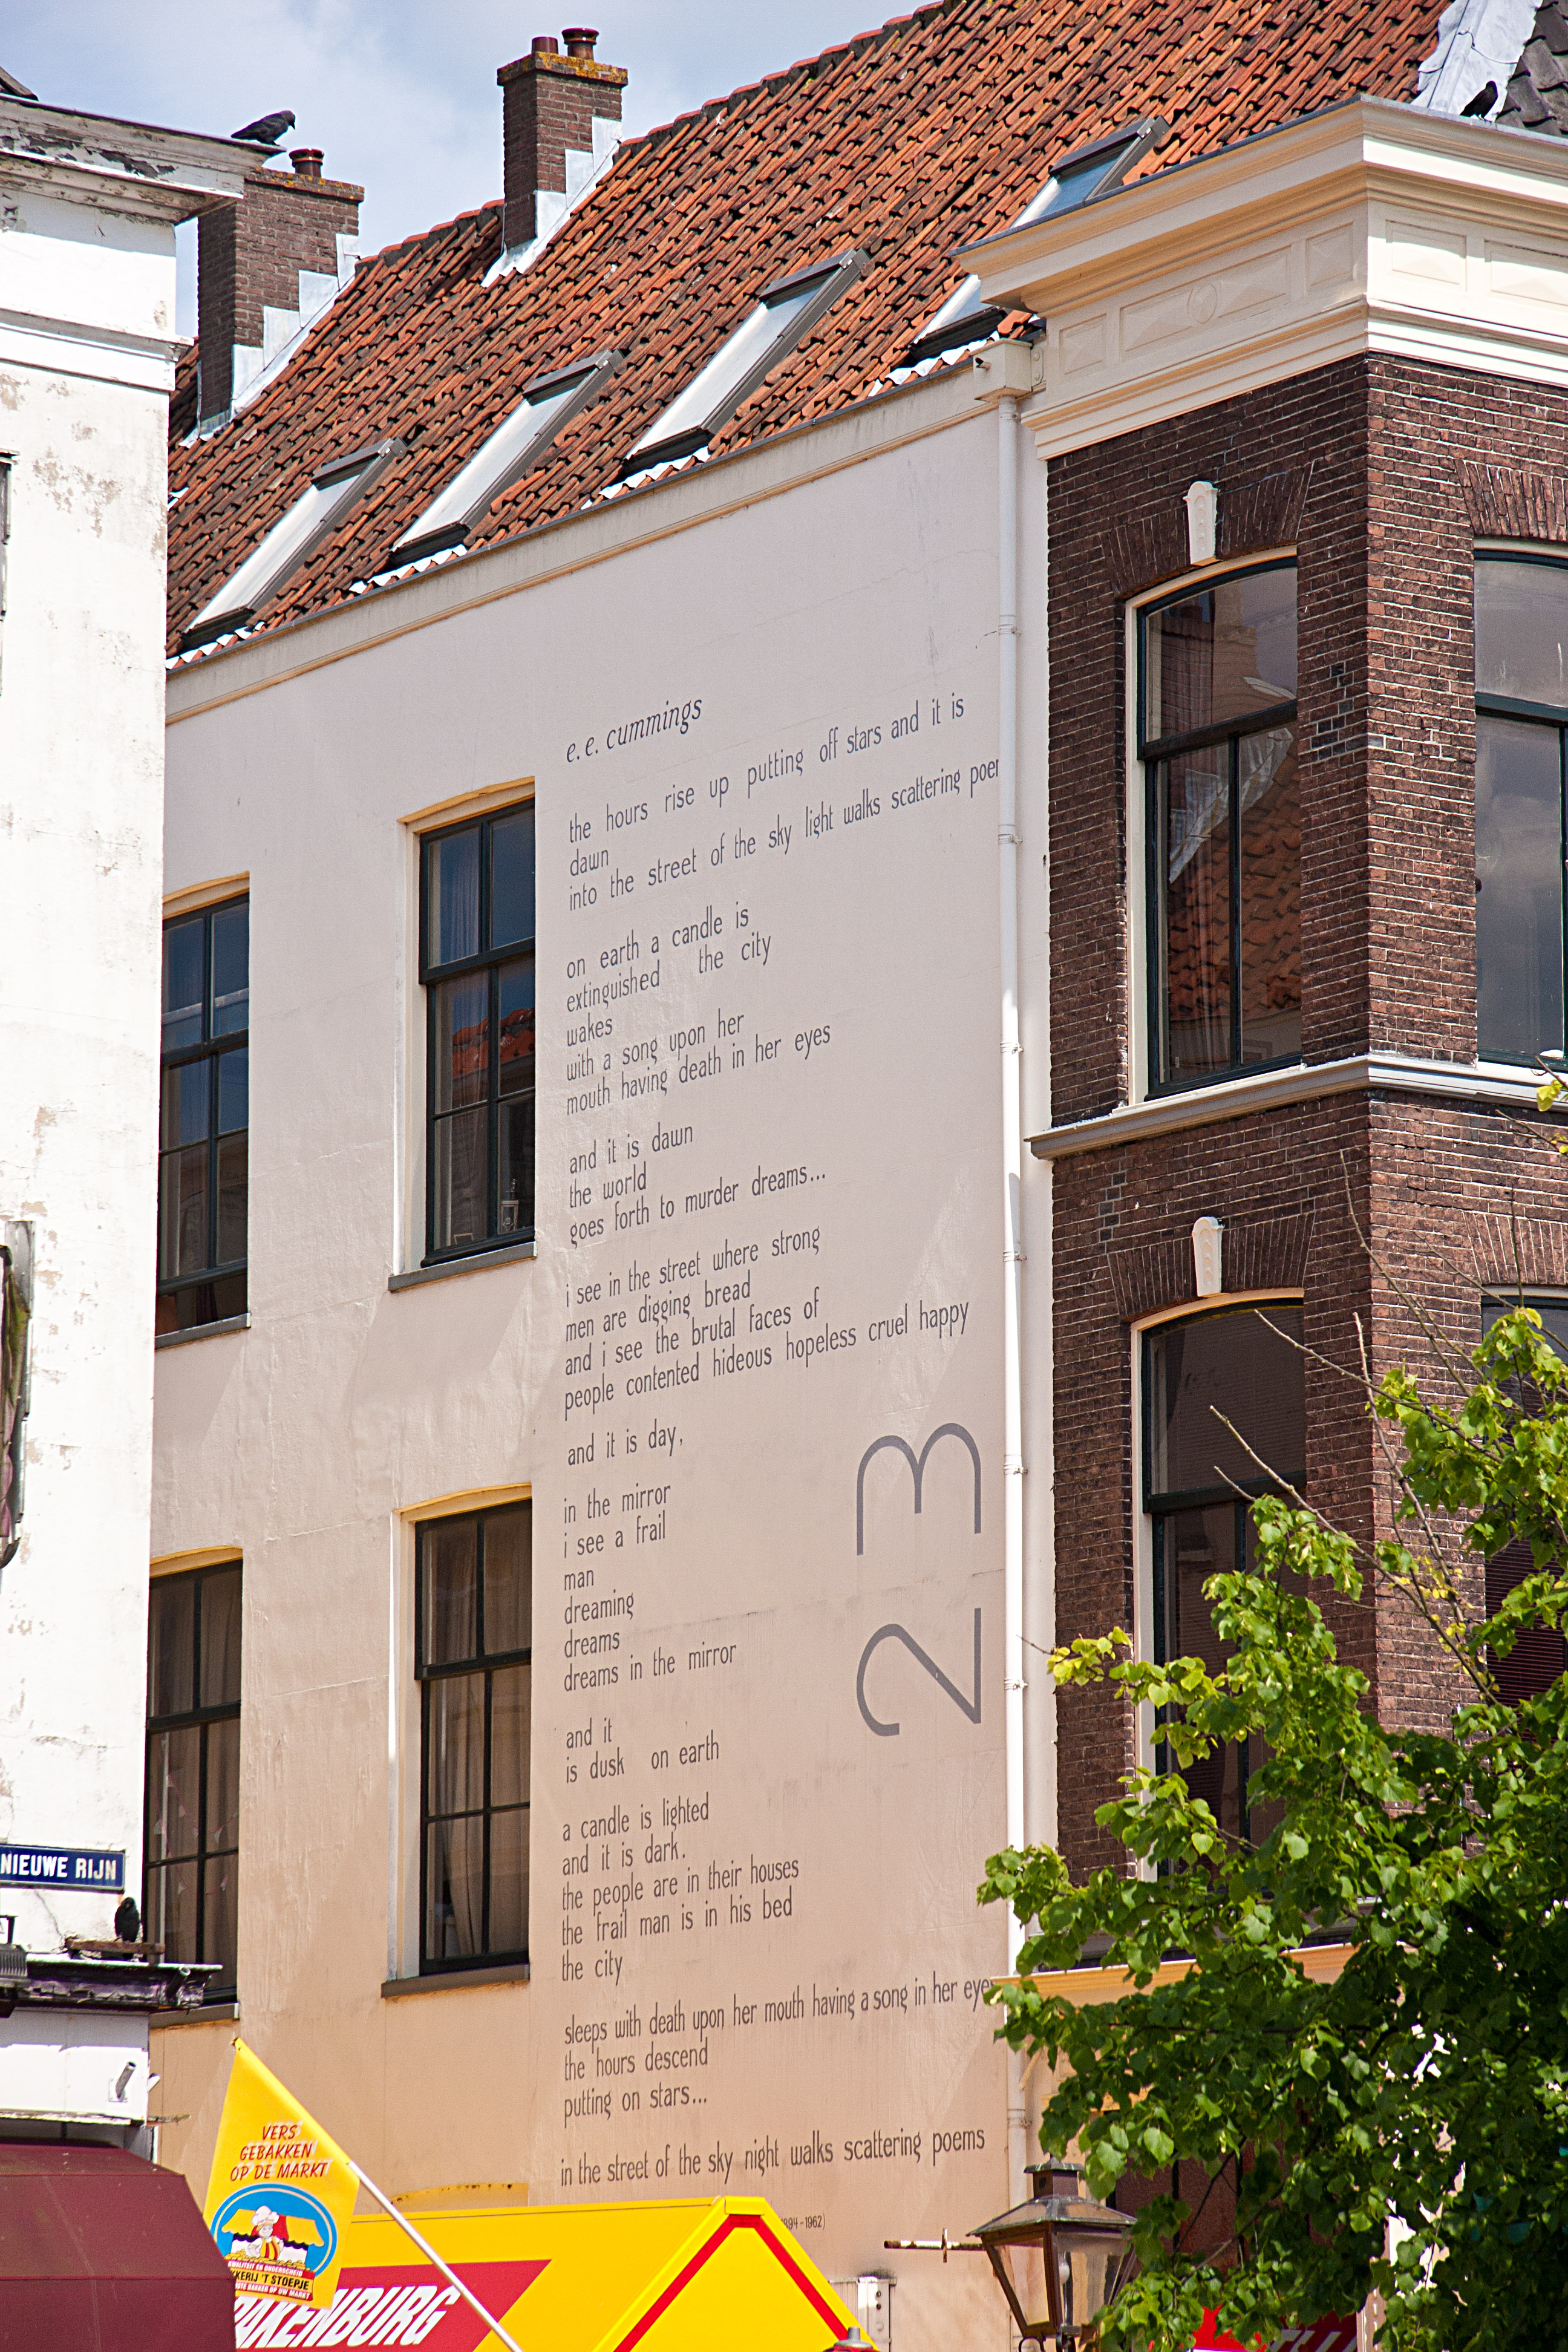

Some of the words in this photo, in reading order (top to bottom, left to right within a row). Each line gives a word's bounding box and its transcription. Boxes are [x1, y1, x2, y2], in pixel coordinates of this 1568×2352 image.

[566, 743, 580, 763] e.
[585, 736, 598, 757] e.
[606, 699, 702, 750] cummings
[569, 812, 591, 843] the
[606, 802, 648, 832] hours
[665, 784, 694, 813] rise
[710, 776, 729, 808] up
[748, 748, 803, 799] putting
[819, 726, 838, 763] off
[846, 726, 882, 754] stars
[890, 699, 919, 739] and
[932, 698, 941, 726] it
[952, 692, 964, 719] is
[570, 883, 597, 911] into
[610, 867, 634, 898] the
[648, 848, 697, 886] street
[710, 832, 725, 866] of
[734, 827, 756, 859] the
[768, 814, 792, 855] sky
[805, 801, 834, 838] light
[843, 788, 881, 825] walks
[891, 768, 961, 809] scattering
[570, 848, 609, 877] dawn
[566, 958, 586, 979] on
[599, 929, 639, 969] earth
[651, 936, 659, 954] a
[671, 904, 723, 947] candle
[736, 901, 749, 929] is
[567, 959, 660, 1013] extinguished
[699, 944, 724, 974] the
[741, 931, 771, 966] city
[567, 1012, 613, 1047] wakes
[567, 1047, 594, 1082] with
[603, 1053, 611, 1071] a
[622, 1037, 658, 1065] song
[670, 1025, 705, 1061] upon
[717, 1008, 745, 1039] her
[567, 1076, 610, 1116] mouth
[621, 1066, 668, 1100] having
[678, 1045, 721, 1083] death
[732, 1042, 745, 1069] in
[755, 1033, 782, 1063] her
[794, 1025, 831, 1060] eyes
[569, 1178, 592, 1209] the
[603, 1160, 647, 1200] world
[570, 1218, 604, 1249] goes
[615, 1195, 649, 1231] forth
[660, 1194, 675, 1220] to
[685, 1176, 739, 1214] murder
[566, 1284, 570, 1308] i
[577, 1283, 601, 1305] see
[609, 1272, 621, 1297] in
[629, 1259, 650, 1292] the
[659, 1251, 701, 1284] street
[713, 1238, 759, 1271] where
[771, 1226, 820, 1257] strong
[565, 1342, 592, 1376] and
[603, 1341, 606, 1367] i
[615, 1341, 642, 1364] see
[656, 1324, 679, 1354] the
[691, 1307, 736, 1347] brutal
[750, 1303, 791, 1333] faces
[803, 1285, 820, 1320] of
[566, 1319, 594, 1342] men
[603, 1310, 627, 1333] are
[638, 1290, 691, 1327] digging
[704, 1269, 751, 1308] bread
[564, 1373, 614, 1422] people
[626, 1351, 699, 1396] contented
[713, 1343, 773, 1377] hideous
[786, 1322, 857, 1368] hopeless
[868, 1302, 908, 1342] cruel
[920, 1299, 969, 1339] happy
[564, 1498, 576, 1524] in
[587, 1488, 610, 1519] the
[622, 1482, 671, 1512] mirror
[564, 1569, 594, 1591] man
[857, 1422, 982, 1737] 23
[564, 1589, 634, 1625] dreaming
[564, 1628, 620, 1658] dreams
[564, 1662, 619, 1692] dreams
[630, 1654, 642, 1681] in
[653, 1647, 675, 1676] the
[688, 1641, 737, 1670] mirror
[563, 1823, 570, 1842] a
[581, 1805, 630, 1839] candle
[641, 1803, 652, 1830] is
[662, 1791, 709, 1831] lighted
[1, 1854, 68, 1878] NIEUWE
[76, 1858, 117, 1880] RIJN
[562, 1881, 583, 1911] the
[593, 1872, 644, 1917] people
[653, 1877, 678, 1898] are
[687, 1866, 699, 1893] in
[708, 1859, 743, 1891] their
[751, 1854, 799, 1884] houses
[562, 1915, 583, 1946] the
[596, 1909, 627, 1942] frail
[640, 1915, 670, 1936] man
[681, 1903, 693, 1930] is
[705, 1900, 717, 1927] in
[730, 1893, 751, 1924] his
[763, 1884, 792, 1920] bed
[564, 2014, 607, 2054] sleeps
[615, 2004, 641, 2039] with
[649, 1999, 685, 2035] death
[693, 2008, 725, 2043] upon
[733, 1993, 757, 2027] her
[765, 1985, 805, 2022] mouth
[812, 1983, 855, 2020] having
[860, 1992, 869, 2011] a
[873, 1985, 908, 2014] song
[915, 1977, 926, 2006] in
[933, 1970, 958, 2004] her
[964, 1978, 995, 2013] eye
[564, 2050, 585, 2081] the
[596, 2047, 636, 2077] hours
[645, 2036, 708, 2071] descend
[262, 2124, 298, 2140] VERS
[564, 2087, 612, 2129] putting
[621, 2091, 640, 2112] on
[230, 2165, 249, 2181] OP
[254, 2164, 272, 2180] DE
[276, 2162, 328, 2178] MARKT
[240, 2143, 313, 2161] GEBAKKEN
[561, 2158, 572, 2187] in
[578, 2152, 601, 2185] the
[607, 2151, 649, 2182] street
[655, 2143, 671, 2178] of
[679, 2143, 701, 2175] the
[708, 2140, 734, 2185] sky
[745, 2135, 779, 2177] night
[791, 2129, 834, 2166] walks
[844, 2128, 921, 2163] scattering
[932, 2129, 985, 2167] poems
[261, 2273, 270, 2283] 'T
[270, 2275, 310, 2290] STOEPJE
[264, 2264, 303, 2276] ONDERSCHEID
[289, 2289, 310, 2299] MARKT
